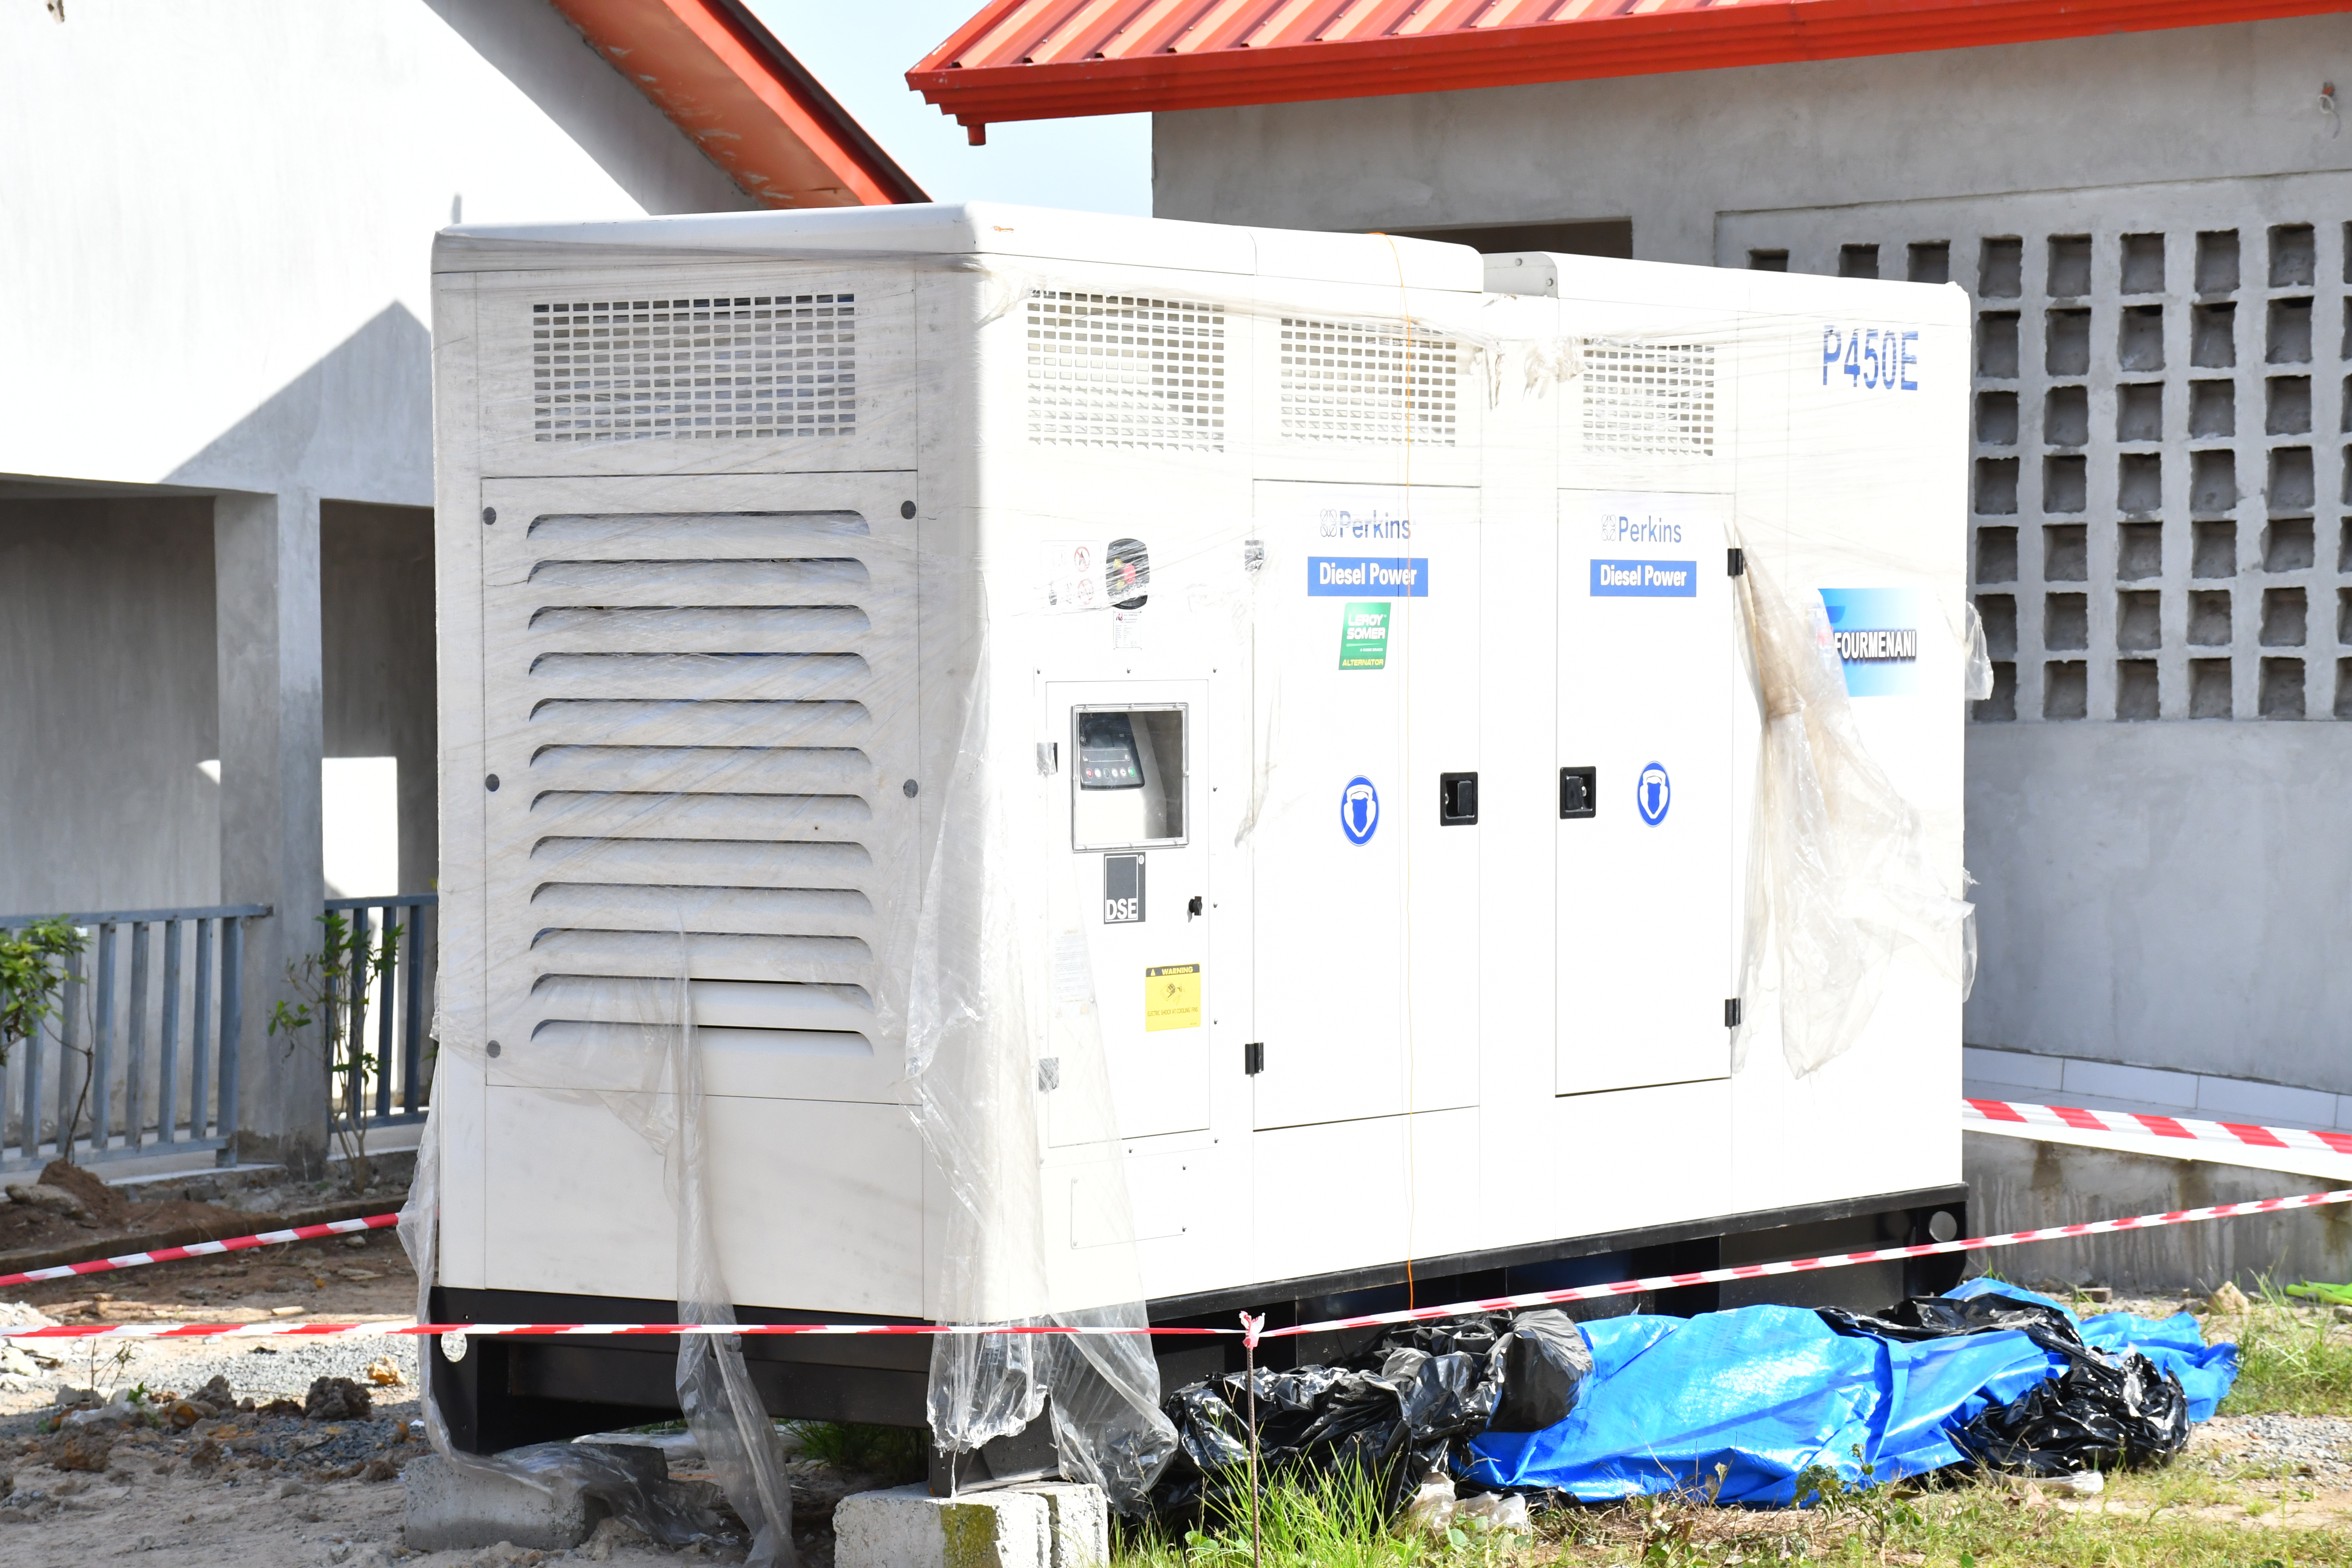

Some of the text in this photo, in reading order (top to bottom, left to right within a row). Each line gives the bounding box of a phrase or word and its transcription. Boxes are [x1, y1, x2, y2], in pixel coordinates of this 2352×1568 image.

[1823, 324, 1919, 391] P450E
[1339, 509, 1411, 539] Perkins
[1619, 515, 1682, 543] Perkins
[1319, 562, 1417, 585] Diesel Power
[1601, 564, 1687, 586] Diesel Power
[1348, 614, 1384, 626] LEROY
[1346, 627, 1386, 640] SOMER
[1834, 631, 1916, 659] FOURMENANI
[1106, 898, 1137, 920] DSE
[1161, 966, 1193, 975] WARNING
